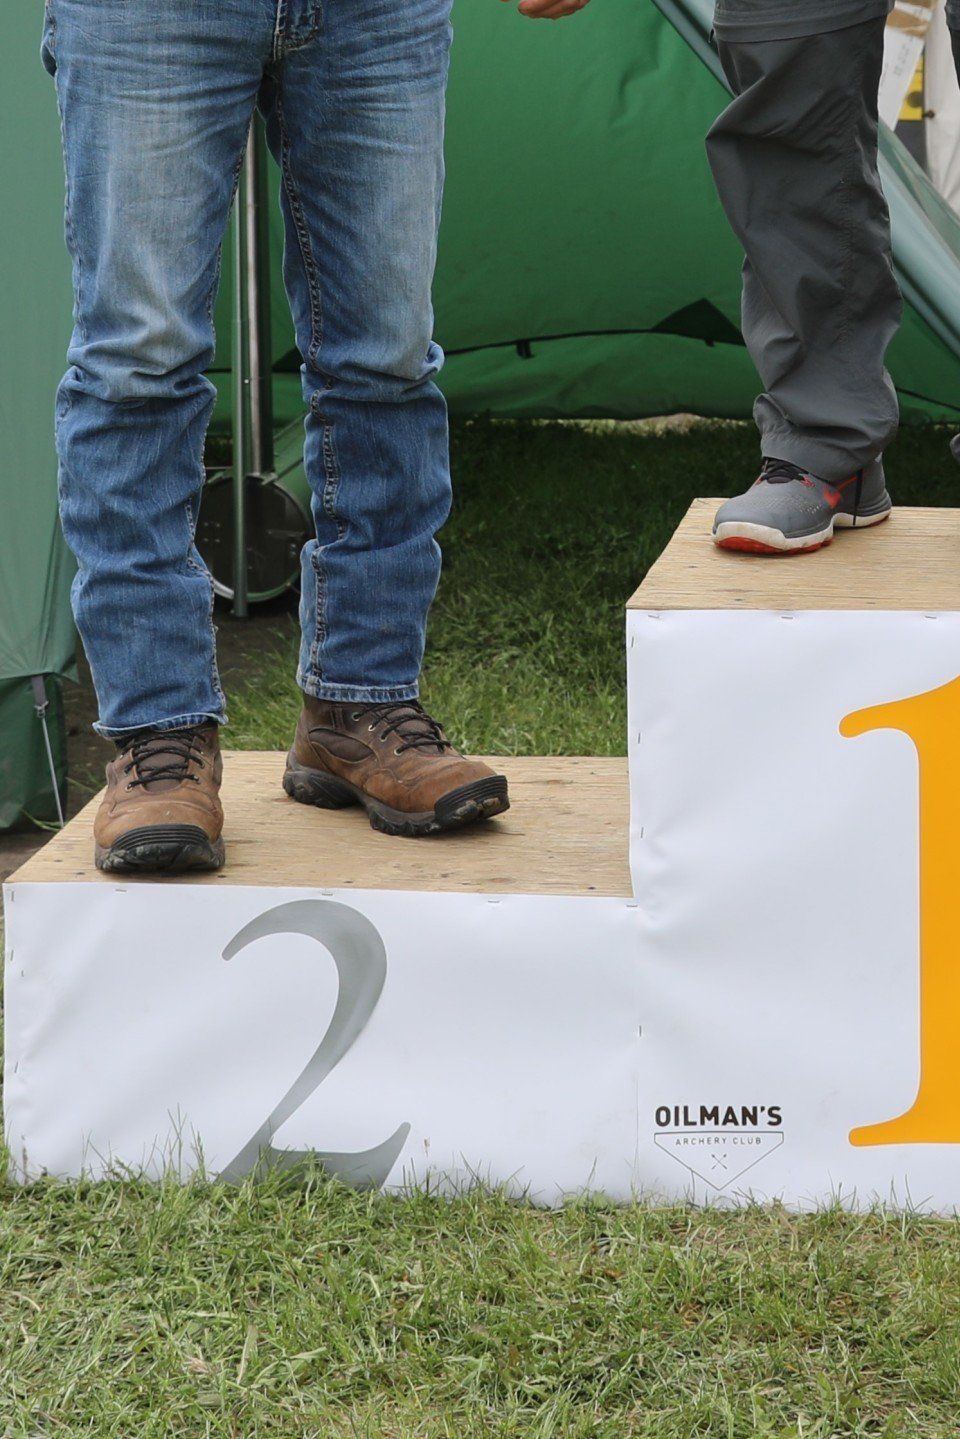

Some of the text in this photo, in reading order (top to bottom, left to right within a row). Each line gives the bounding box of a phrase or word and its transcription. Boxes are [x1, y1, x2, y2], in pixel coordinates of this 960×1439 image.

[214, 898, 412, 1192] 2
[655, 1105, 782, 1127] OILMAN'S
[675, 1137, 762, 1146] ARCHERY CLUB
